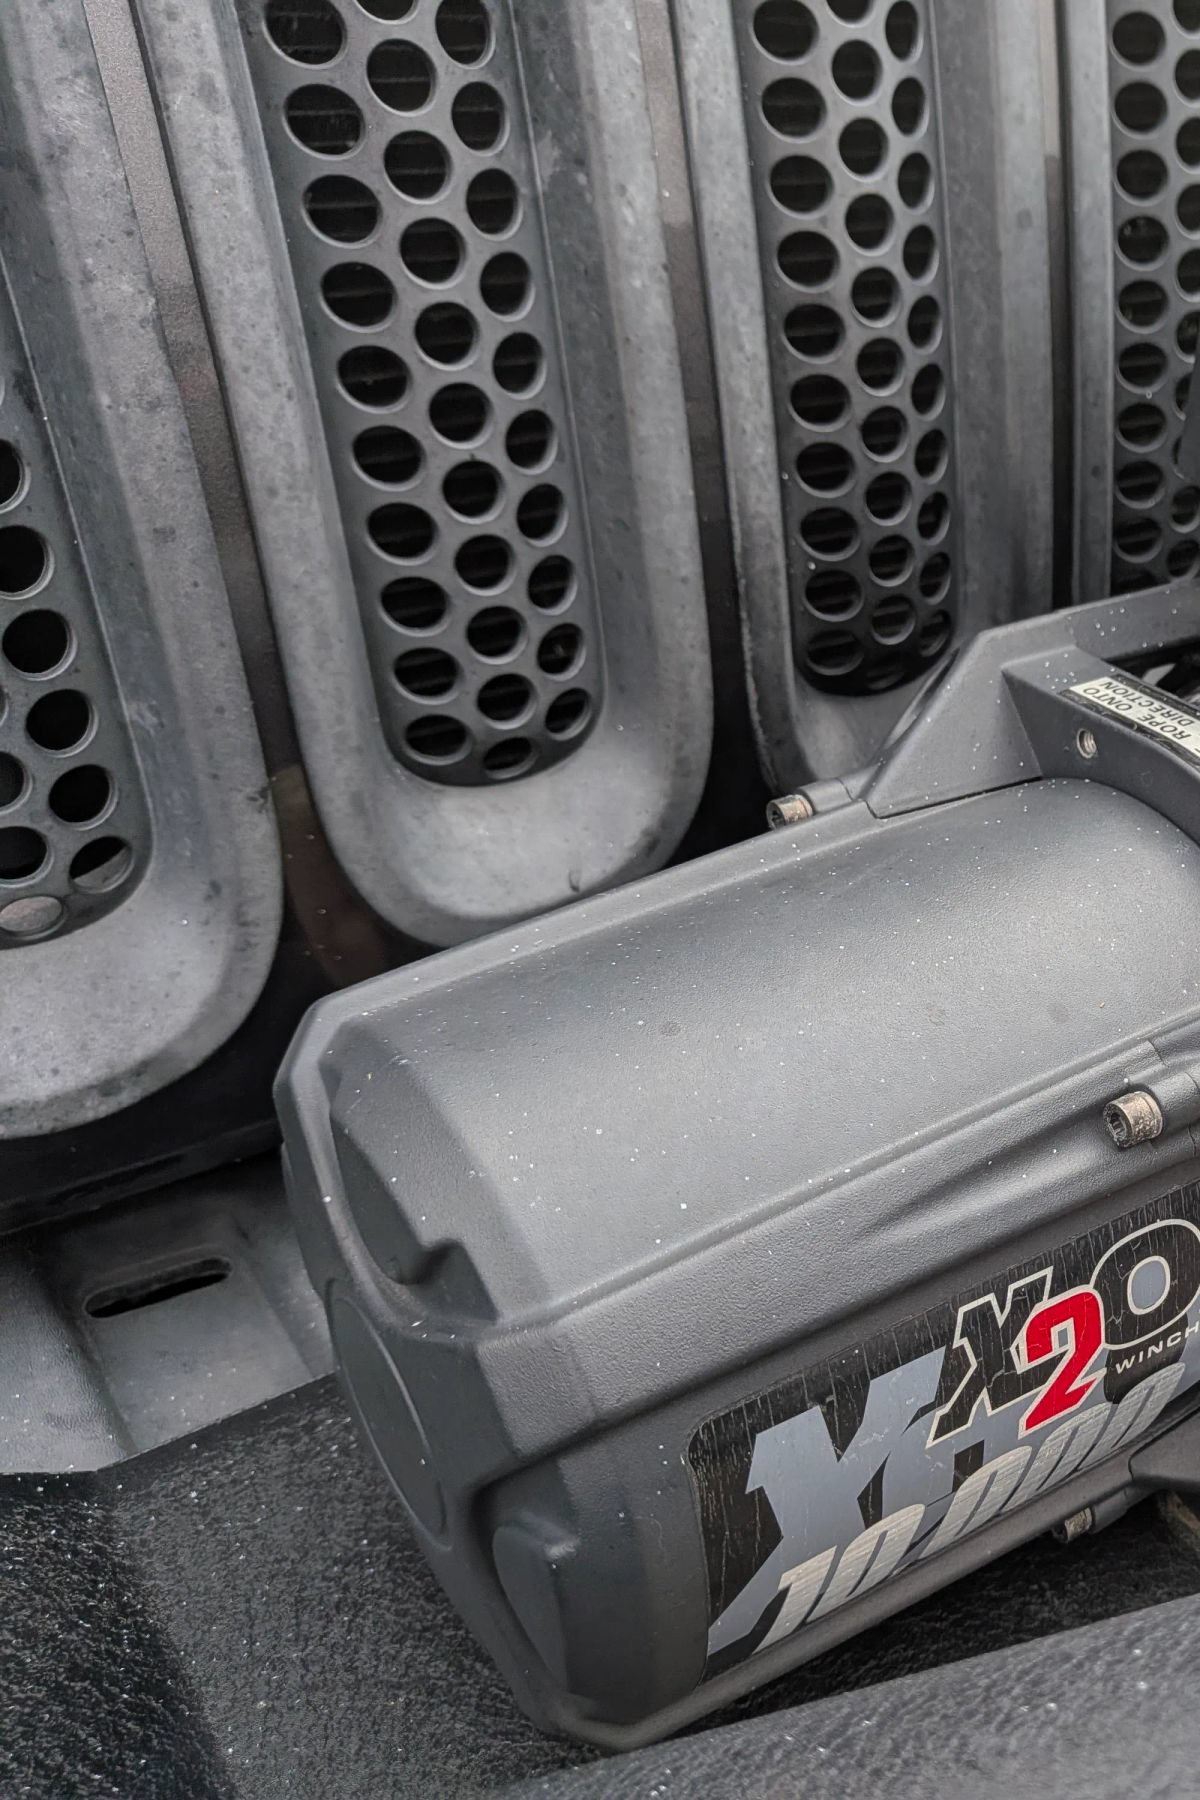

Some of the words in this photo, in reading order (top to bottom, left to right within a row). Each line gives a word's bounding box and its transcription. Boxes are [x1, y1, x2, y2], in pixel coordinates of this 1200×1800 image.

[1083, 687, 1132, 711] ONTO
[1100, 681, 1195, 727] DIRECTION
[1136, 713, 1191, 740] ROPE
[1115, 1320, 1200, 1374] WINCH
